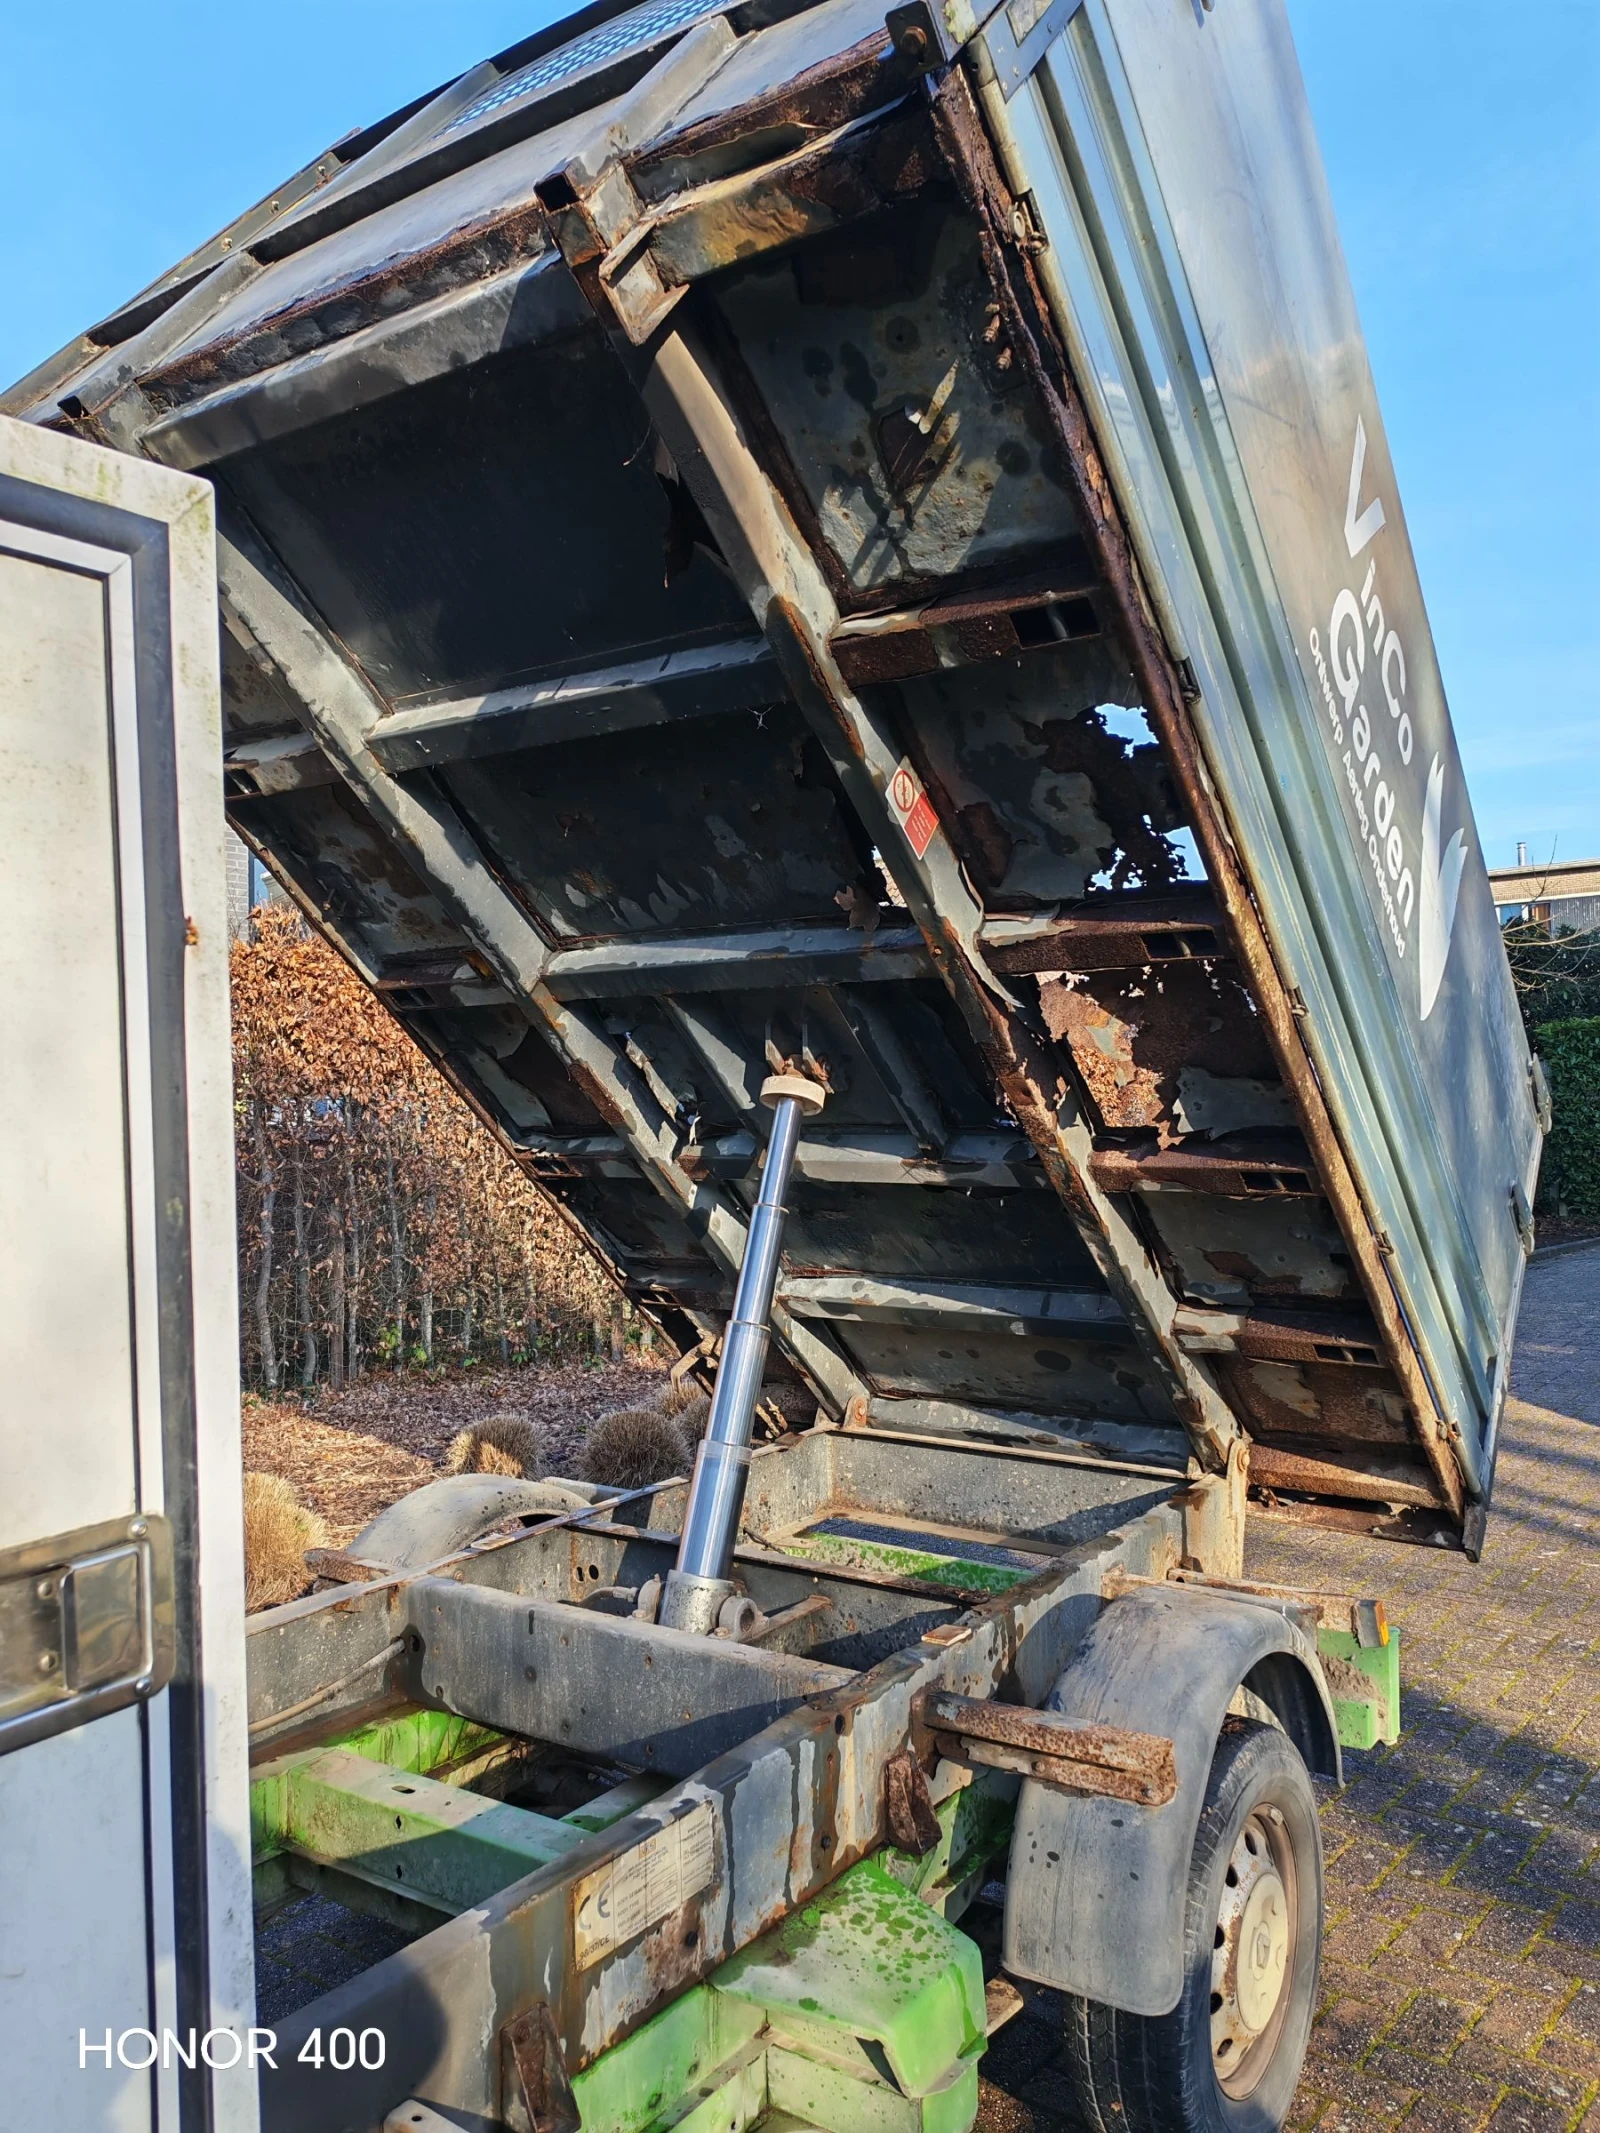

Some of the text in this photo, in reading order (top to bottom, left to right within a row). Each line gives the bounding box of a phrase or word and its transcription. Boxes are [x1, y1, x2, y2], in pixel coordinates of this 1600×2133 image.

[1309, 626, 1344, 745] Ontwerp
[1367, 833, 1406, 959] Onderhoud
[1330, 588, 1413, 928] Garden
[578, 1883, 611, 1931] CE
